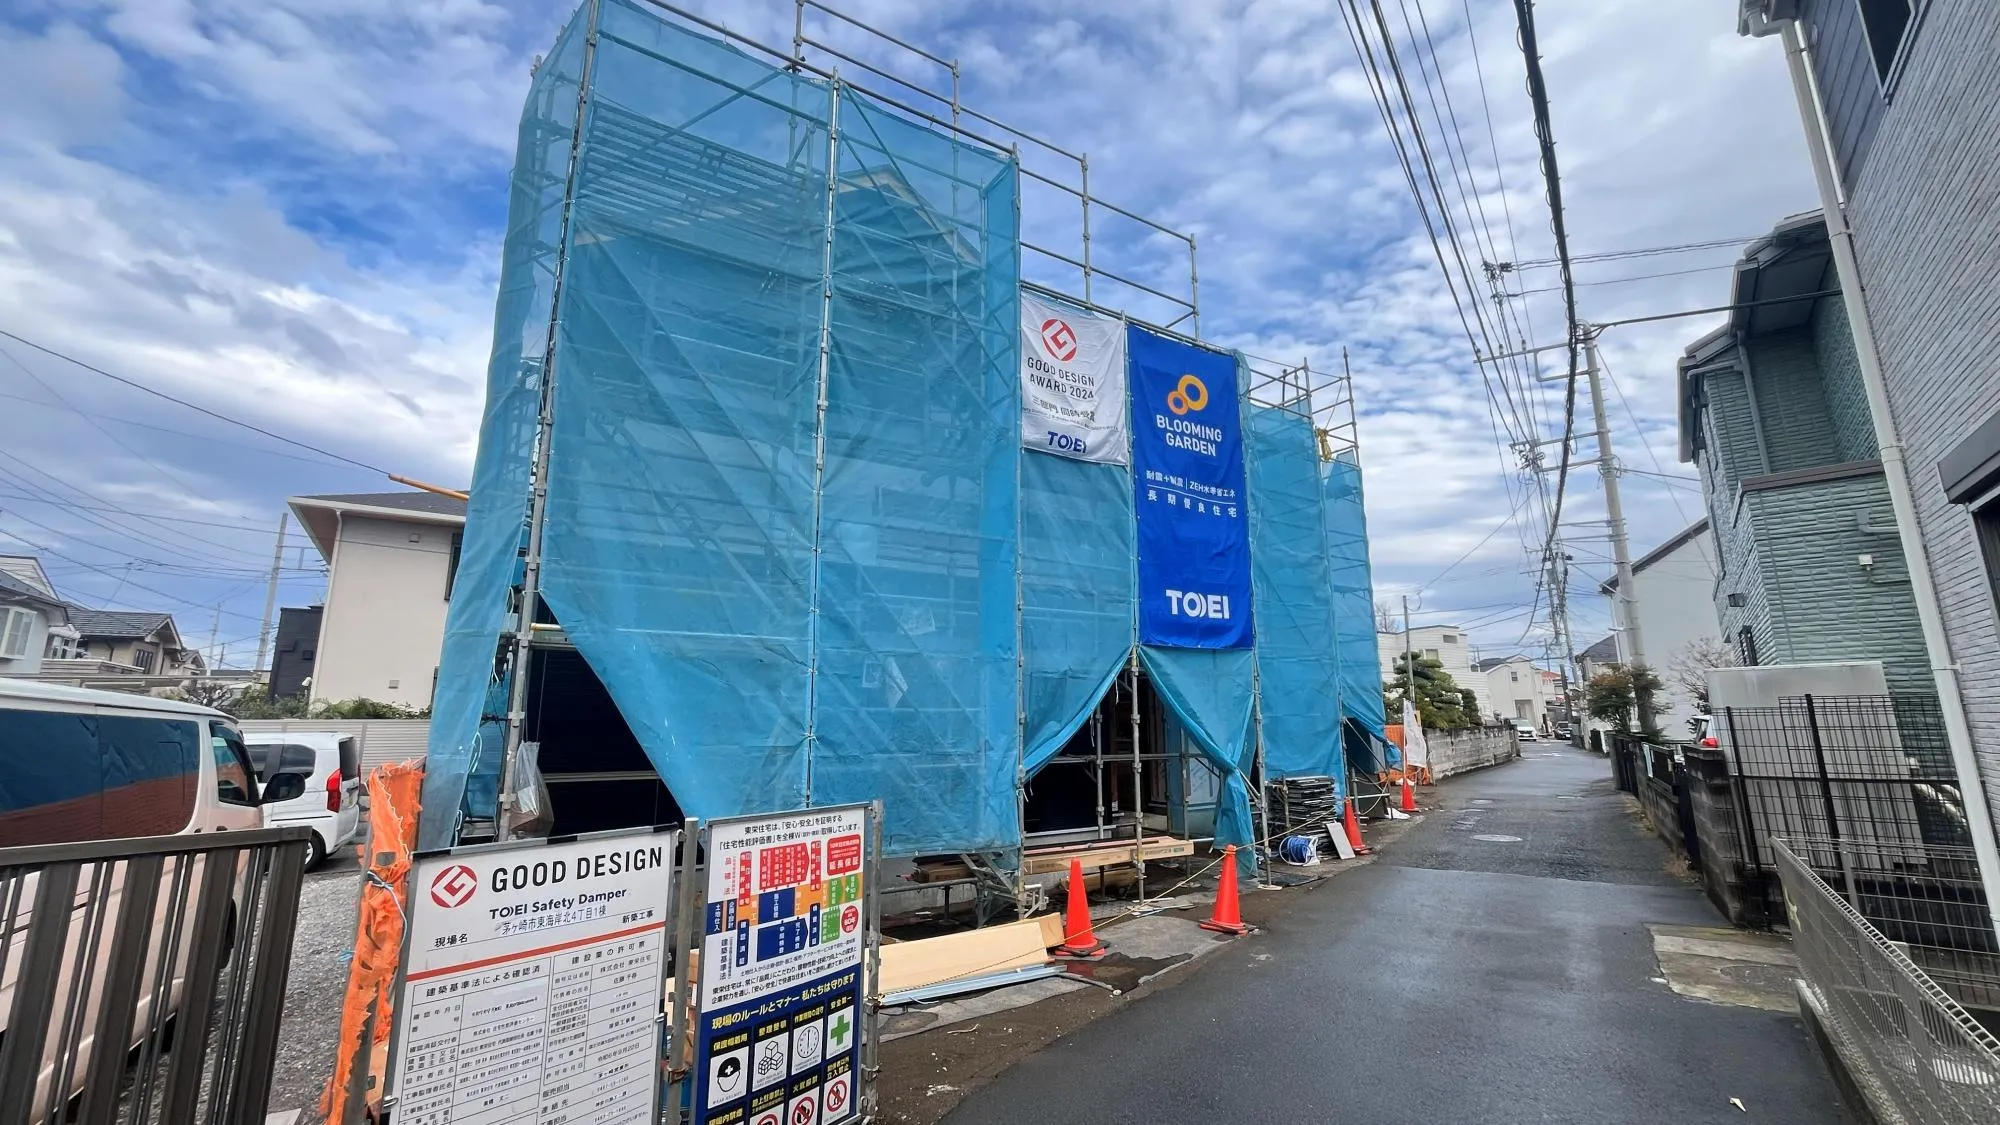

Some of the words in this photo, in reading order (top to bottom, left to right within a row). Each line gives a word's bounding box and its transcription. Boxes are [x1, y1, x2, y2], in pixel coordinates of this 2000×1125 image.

[1027, 357, 1056, 375] GOOD
[1058, 369, 1095, 387] DESIGN
[1029, 374, 1067, 394] AWARD
[1070, 386, 1094, 400] 2024
[1156, 414, 1222, 443] BLOOMING
[1166, 432, 1216, 457] GARDEN
[1165, 589, 1230, 620] TOEI
[491, 860, 567, 893] GOOD
[576, 846, 663, 880] DESIGN
[489, 904, 528, 921] TOEI
[531, 897, 575, 914] Safety
[578, 888, 627, 905] Damper
[622, 910, 654, 925] 新築工事
[434, 933, 468, 948] 現場名
[426, 964, 540, 998] 建築基準法による確認済
[711, 995, 800, 1029] 現場のルールとマナー
